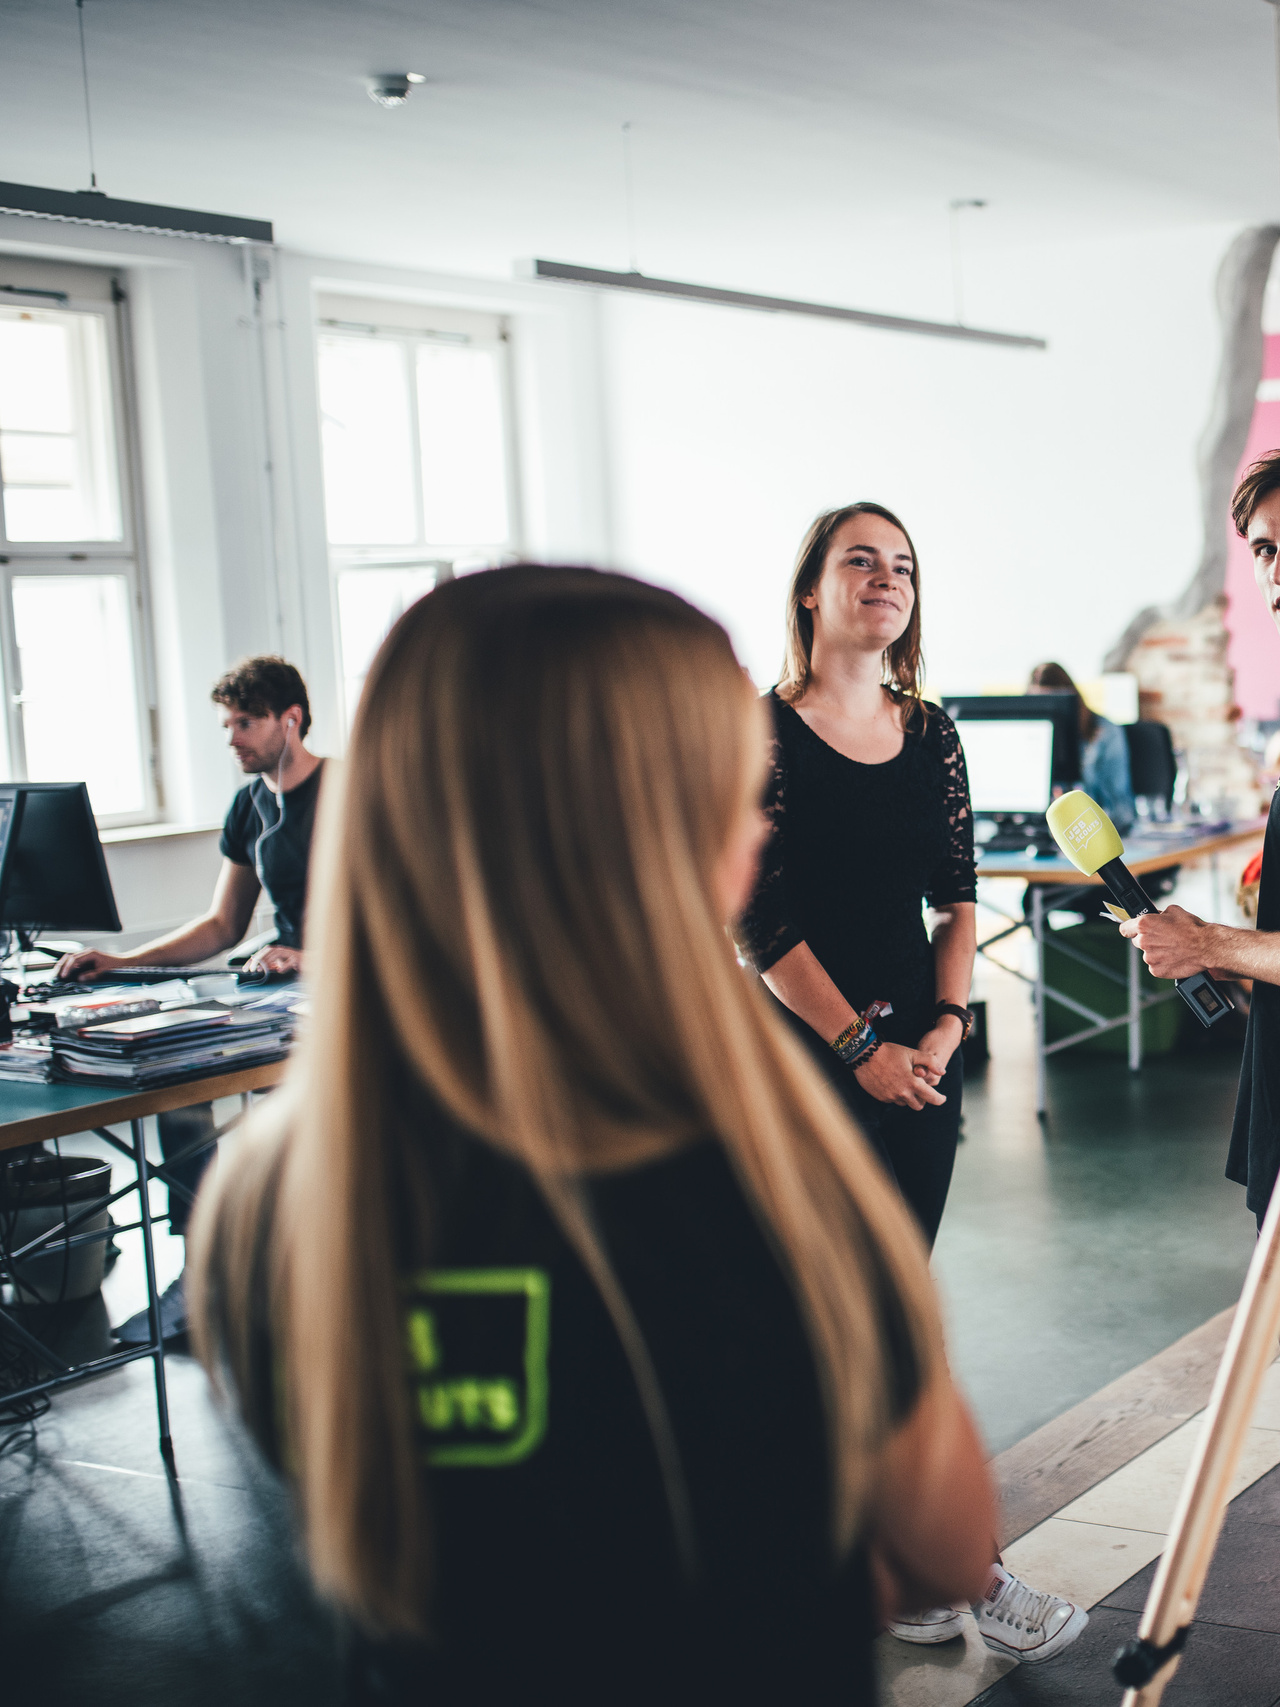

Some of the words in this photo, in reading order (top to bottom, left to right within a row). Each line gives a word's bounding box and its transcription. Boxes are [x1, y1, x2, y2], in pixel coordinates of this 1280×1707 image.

[1068, 820, 1086, 840] JOB
[1075, 819, 1100, 843] SCOUTS
[417, 1376, 518, 1432] UTS
